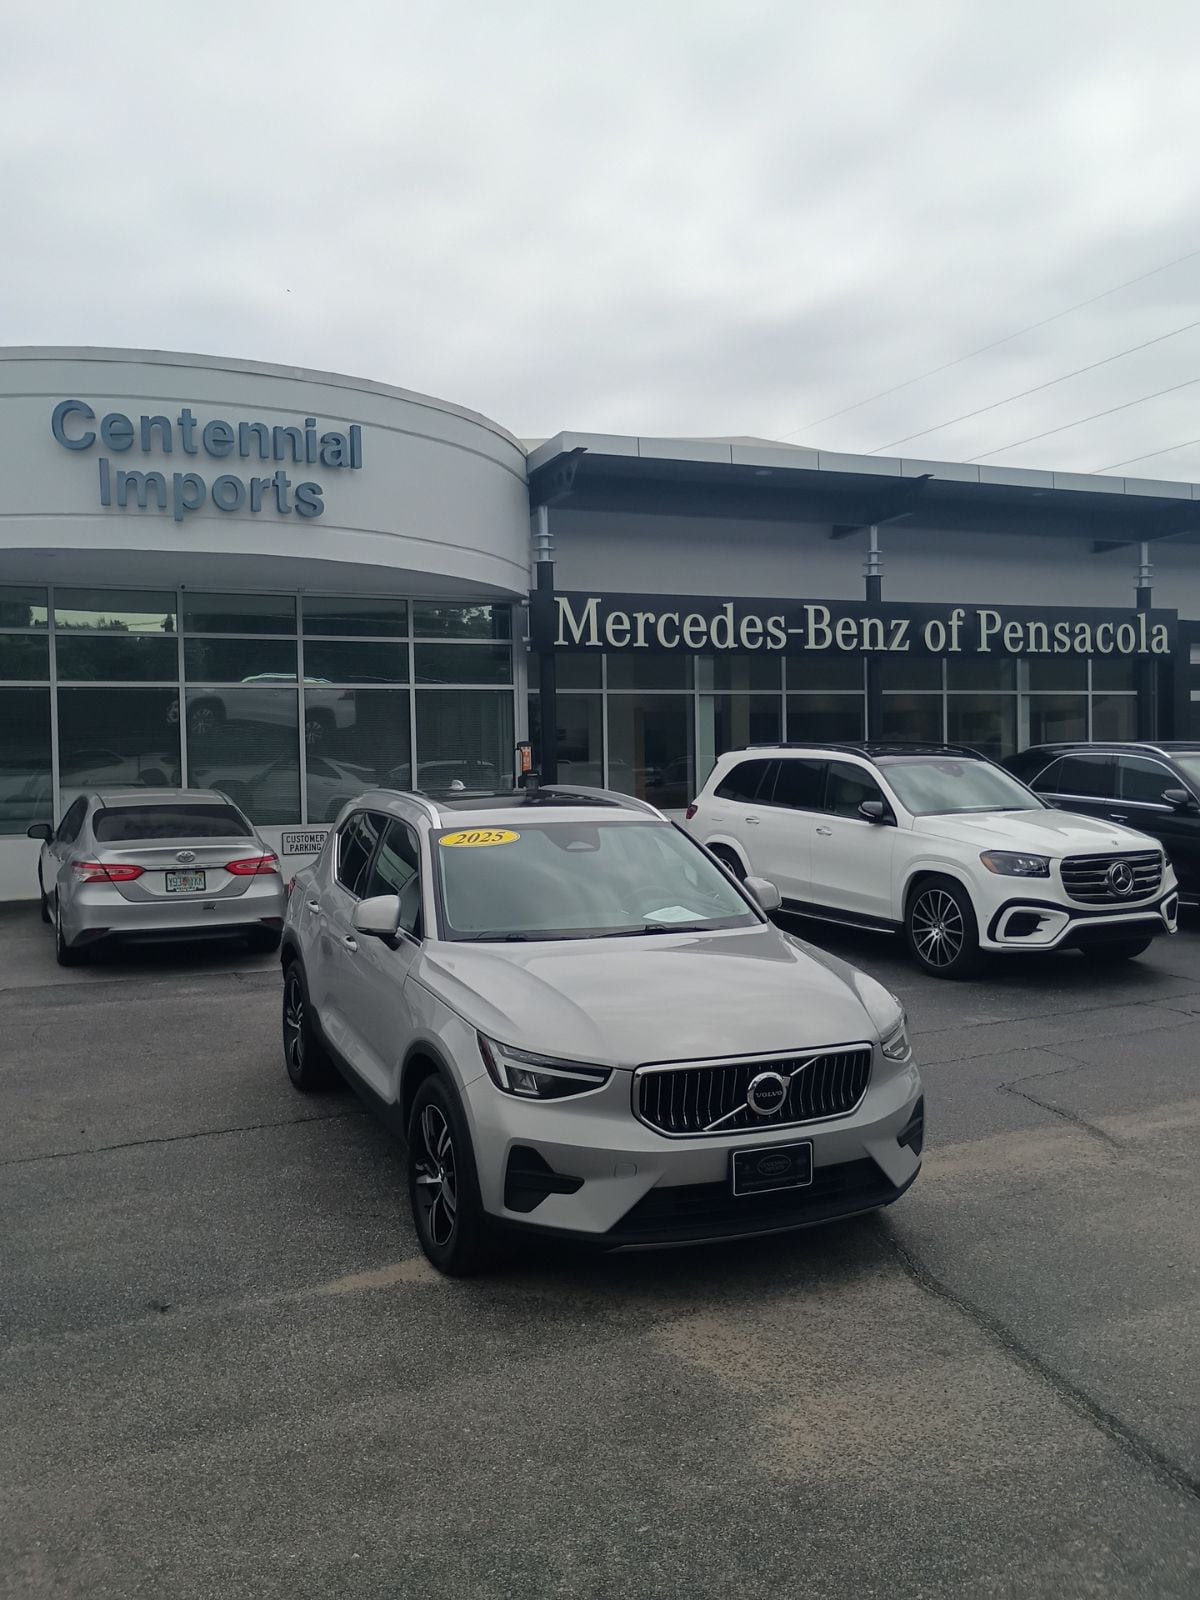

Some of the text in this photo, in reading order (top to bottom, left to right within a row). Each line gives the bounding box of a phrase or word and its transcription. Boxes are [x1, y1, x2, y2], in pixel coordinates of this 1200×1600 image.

[51, 400, 363, 469] Centennial
[99, 458, 325, 521] Imports
[553, 597, 1171, 654] Mercedes-Benz of Pensacola
[286, 834, 325, 843] CUSTOMER
[454, 831, 505, 844] 2025
[289, 843, 322, 852] PARKING
[755, 1090, 783, 1098] VOLVO
